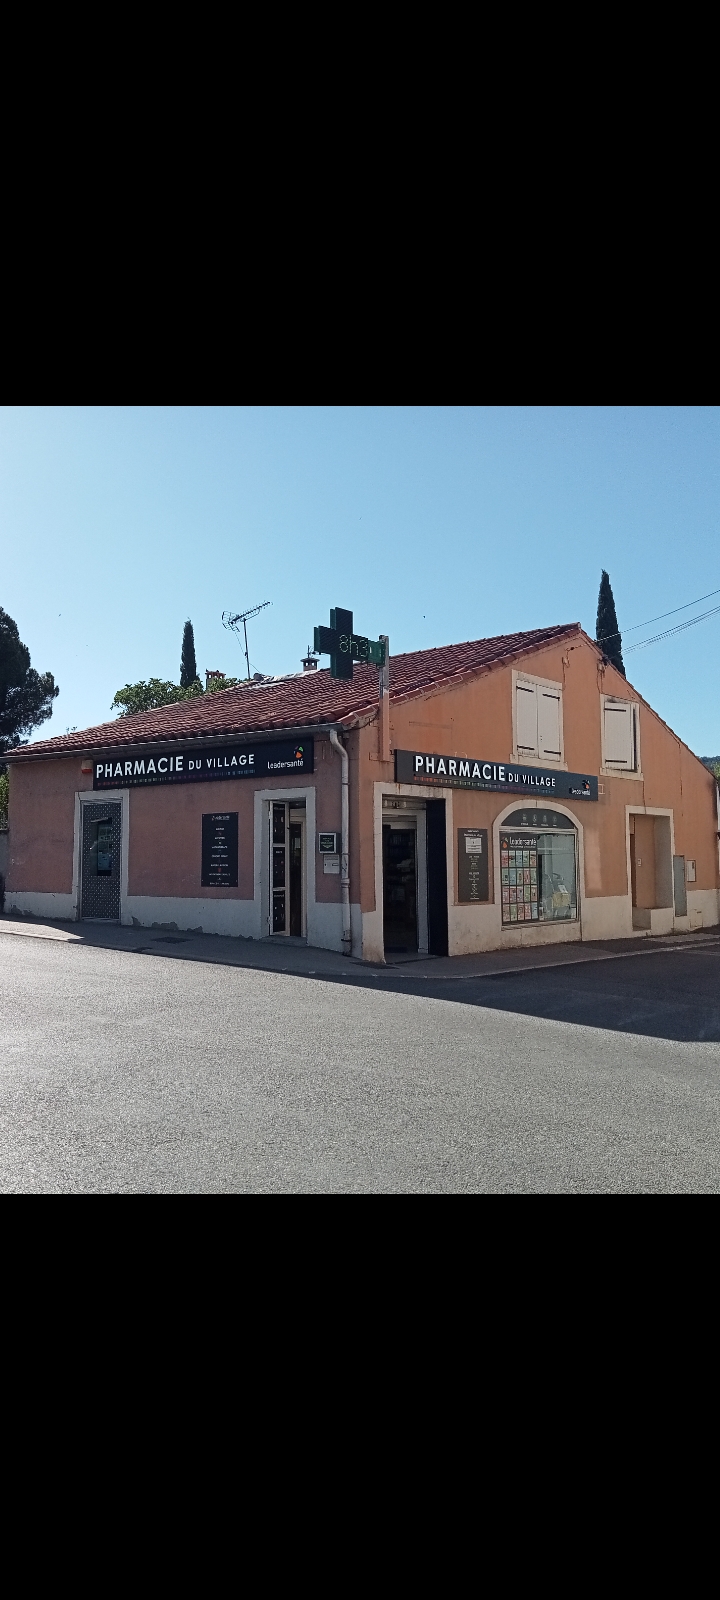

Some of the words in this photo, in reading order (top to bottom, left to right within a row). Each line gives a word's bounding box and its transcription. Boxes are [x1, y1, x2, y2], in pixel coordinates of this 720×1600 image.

[96, 755, 184, 778] PHARMACIE
[188, 759, 202, 770] DU
[206, 754, 255, 768] VILLAGE
[415, 755, 506, 782] PHARMACIE
[508, 772, 519, 783] DU
[522, 774, 556, 788] VILLAGE
